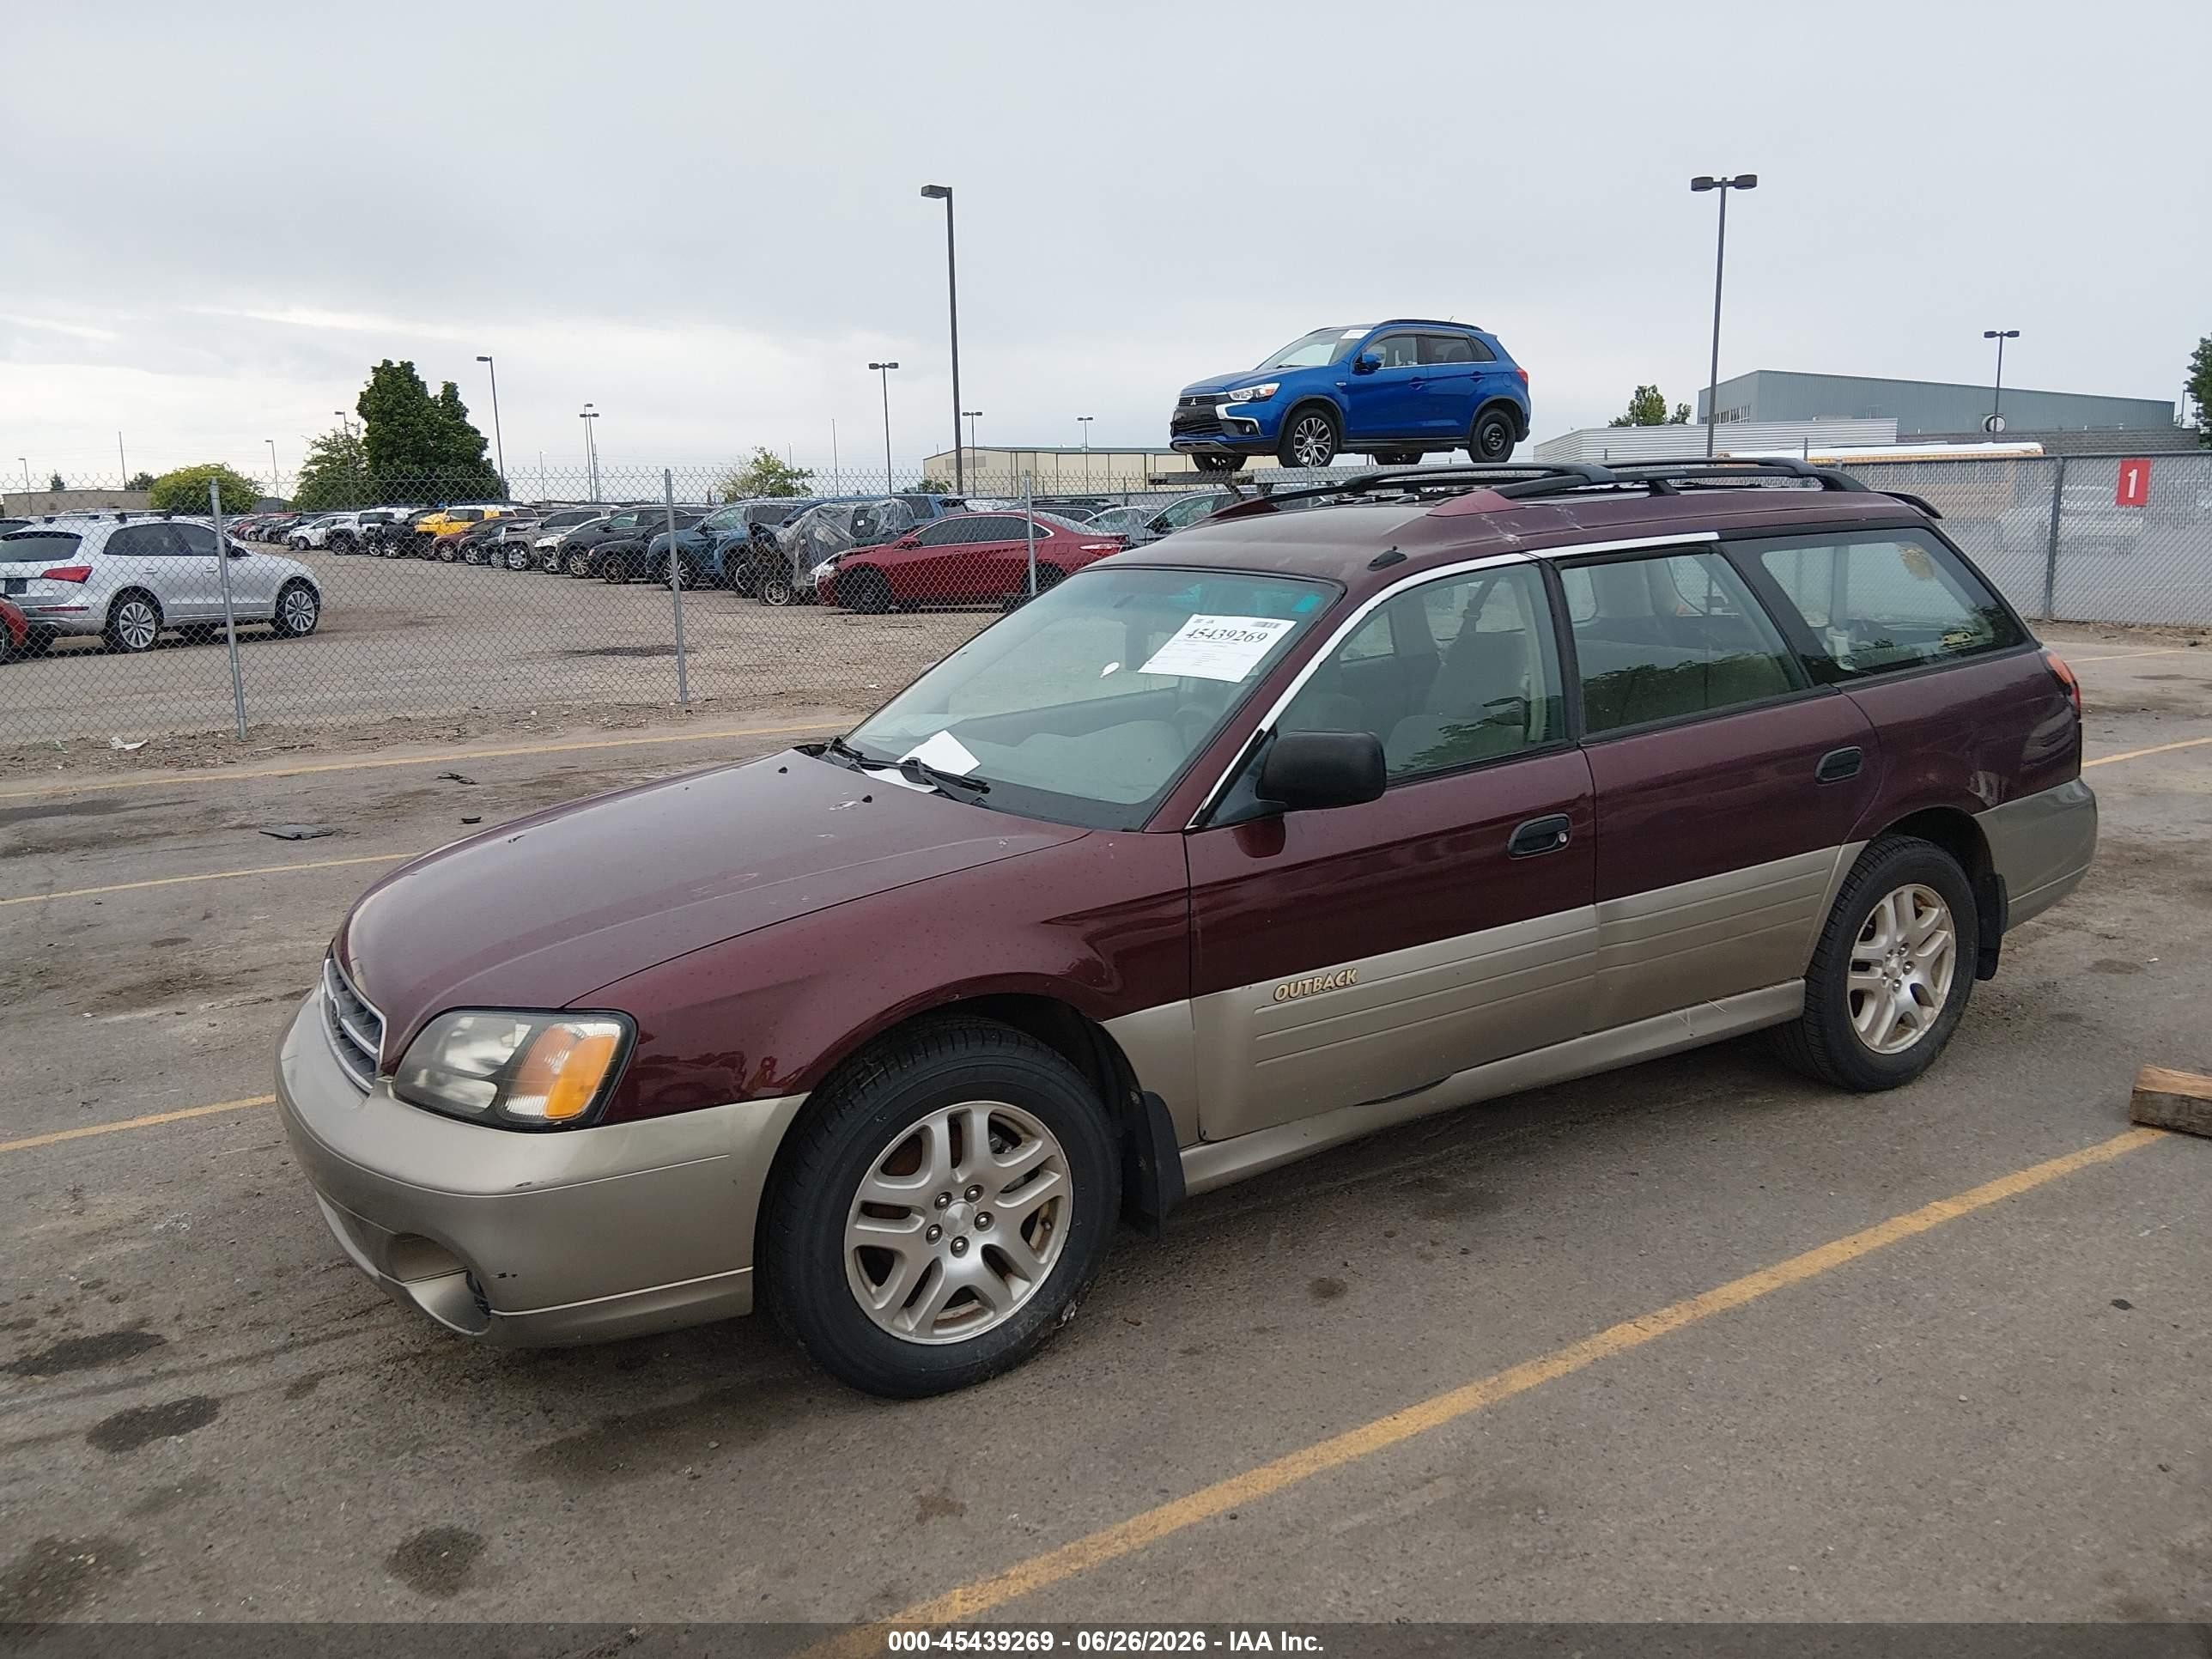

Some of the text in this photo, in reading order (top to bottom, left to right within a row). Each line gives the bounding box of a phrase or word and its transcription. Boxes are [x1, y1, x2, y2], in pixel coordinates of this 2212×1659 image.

[2128, 468, 2138, 499] 1
[1186, 628, 1268, 643] 45439269
[1273, 968, 1358, 1002] OUTBACK
